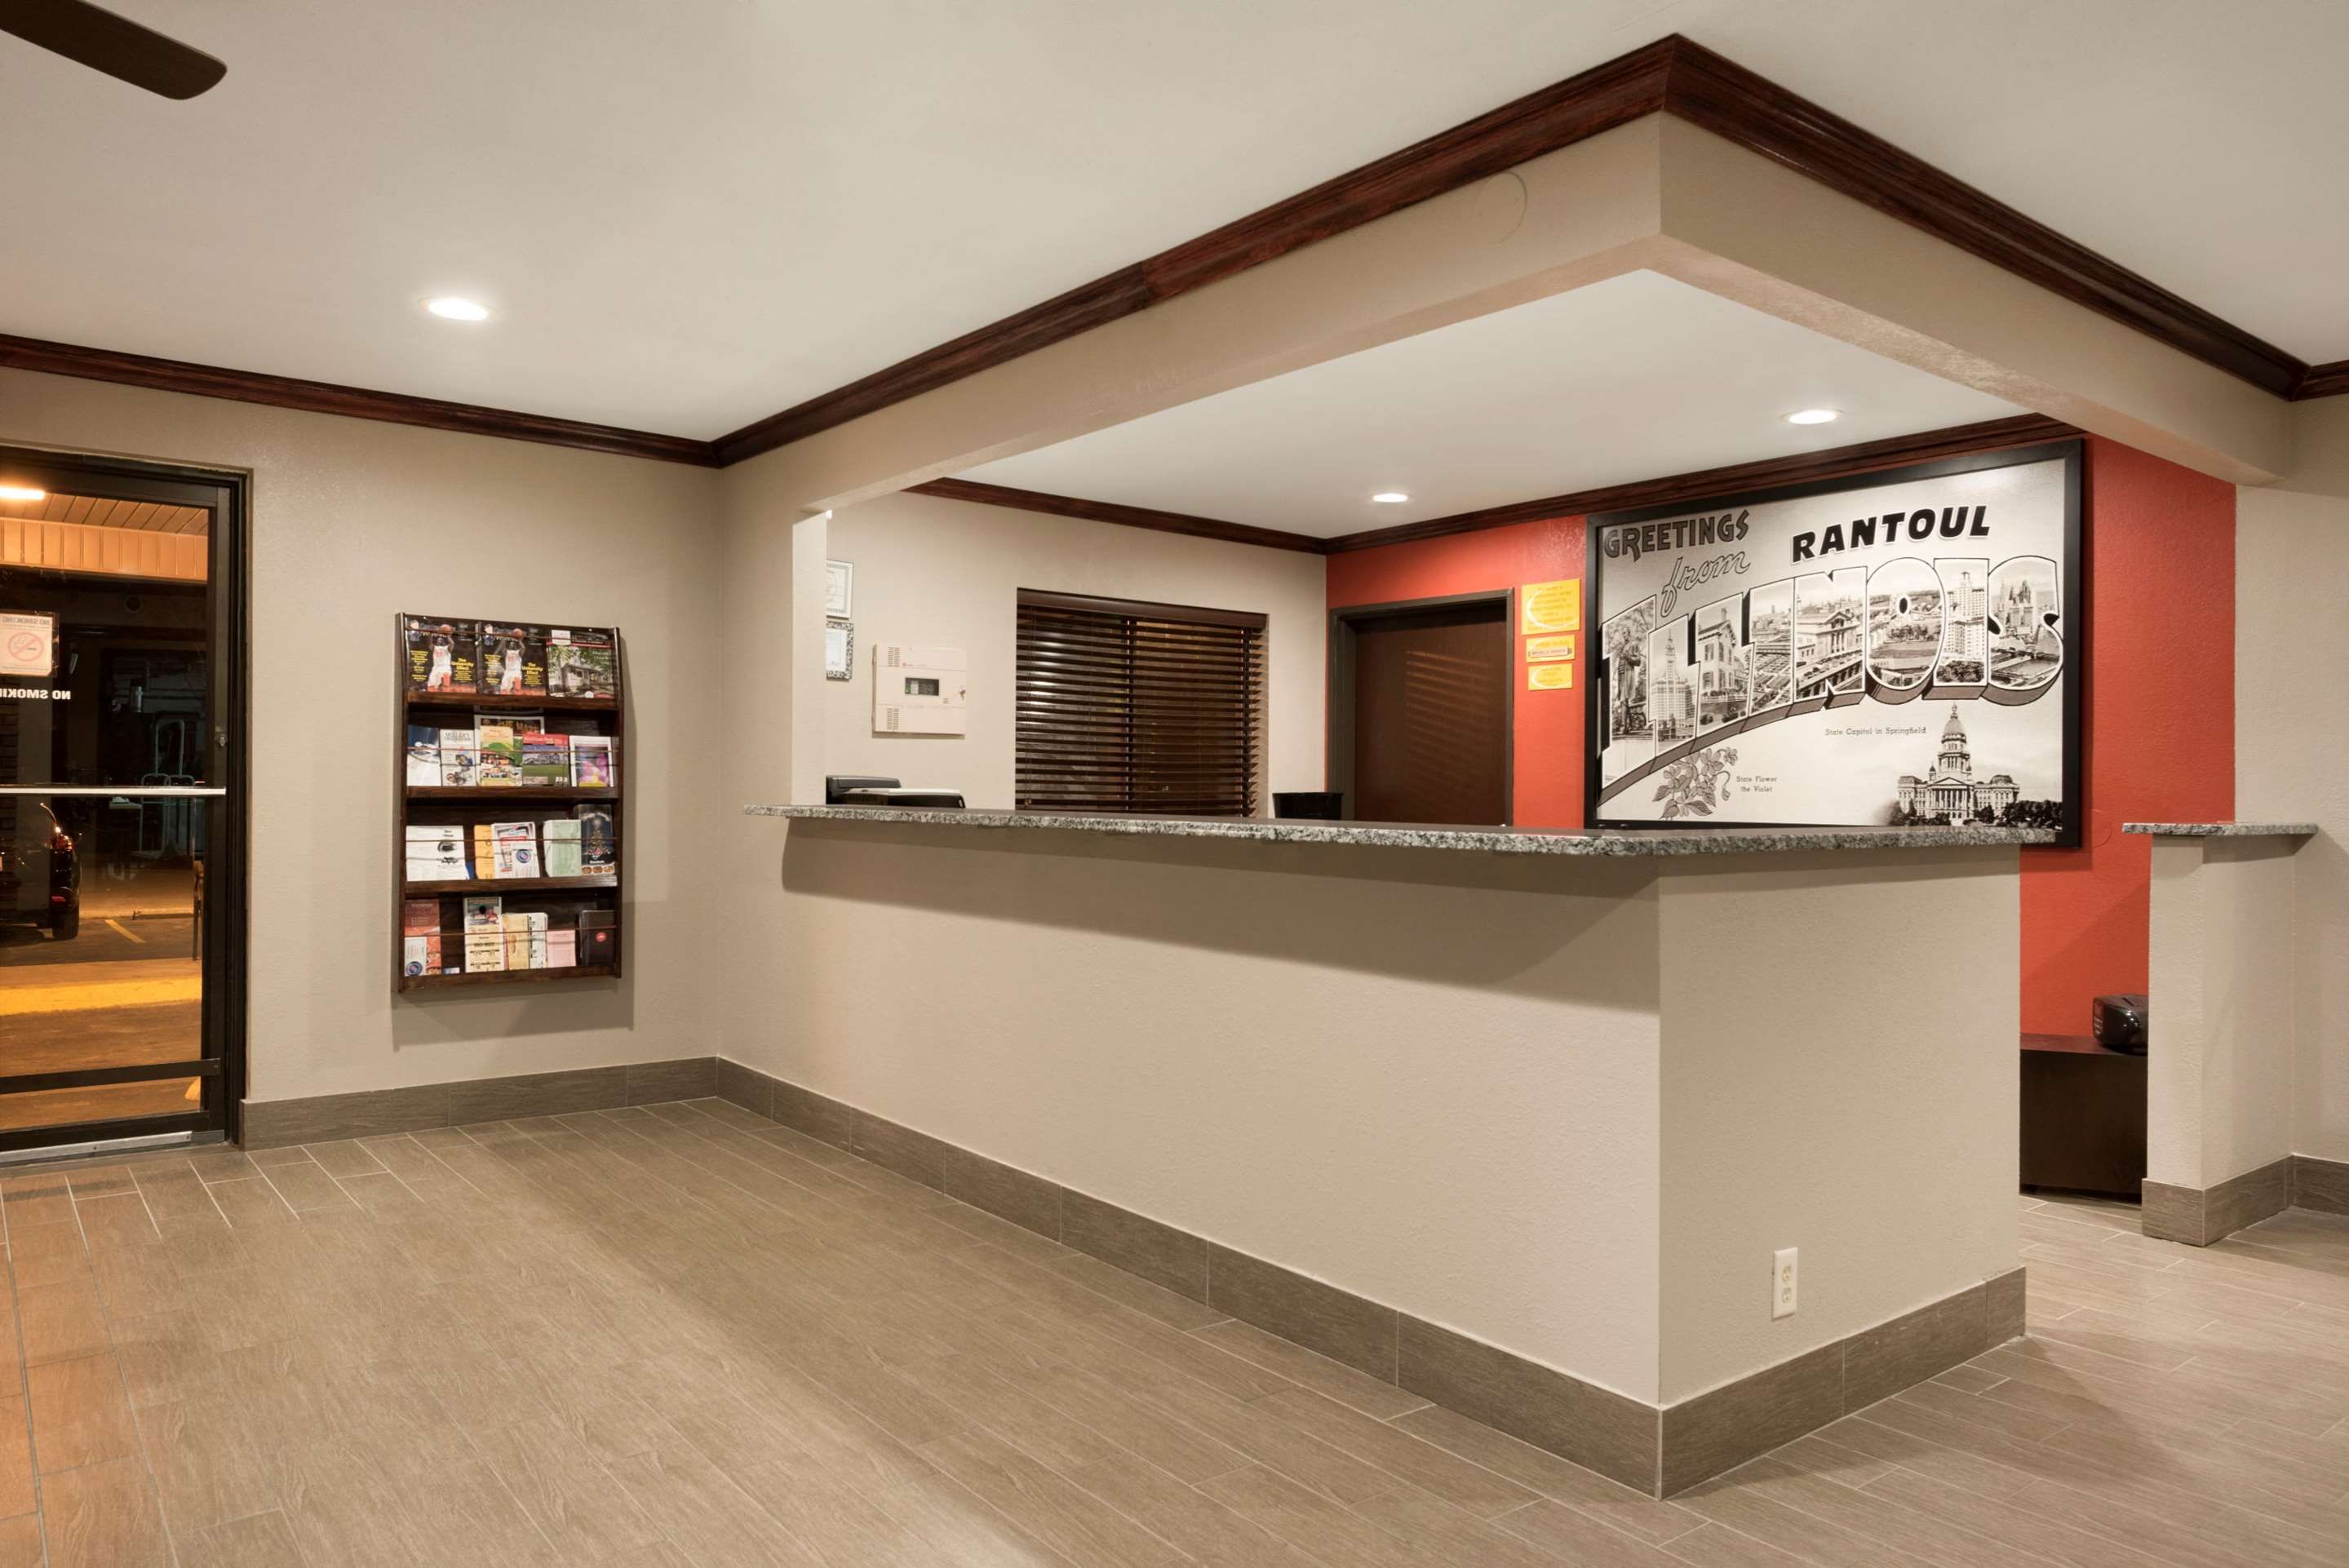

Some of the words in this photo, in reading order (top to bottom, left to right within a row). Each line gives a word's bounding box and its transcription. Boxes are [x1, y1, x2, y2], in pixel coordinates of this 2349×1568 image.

[1602, 508, 1749, 562] GREETINGS
[1790, 504, 1991, 565] RANTOUL
[1659, 549, 1752, 618] from
[1598, 555, 2064, 808] ILLINOIS
[1846, 728, 1873, 737] Capitol
[1886, 726, 1926, 736] Springfield
